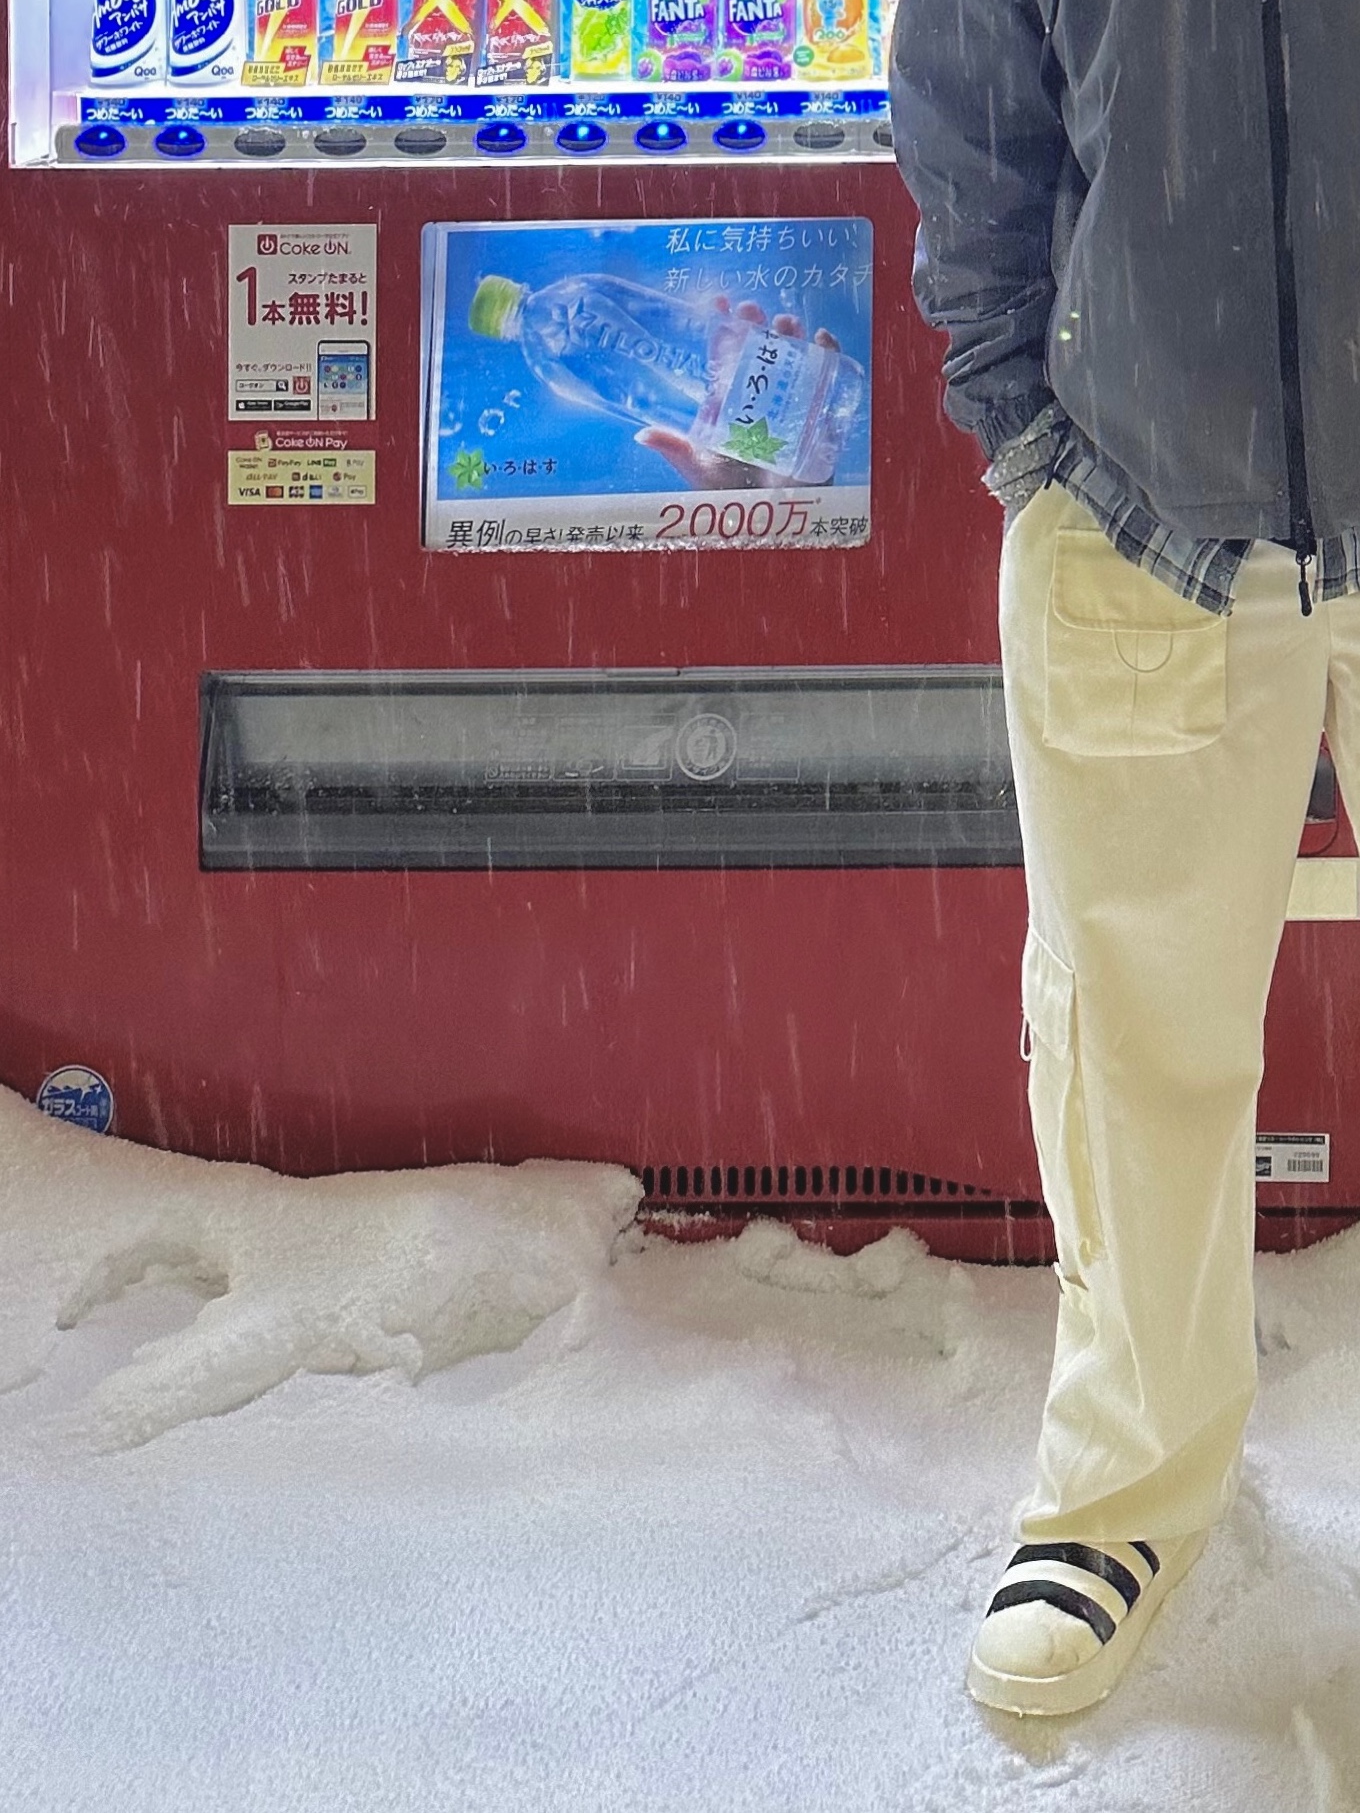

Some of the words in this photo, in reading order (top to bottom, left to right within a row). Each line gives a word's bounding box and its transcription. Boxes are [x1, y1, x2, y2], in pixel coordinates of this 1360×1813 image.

[280, 242, 319, 255] Coke
[288, 273, 367, 284] スタンプたまると
[665, 264, 872, 292] 新しい水のカタチ
[236, 267, 368, 326] 1本無料!
[275, 437, 304, 448] Coke
[326, 437, 348, 450] Pay
[239, 487, 260, 496] VISA
